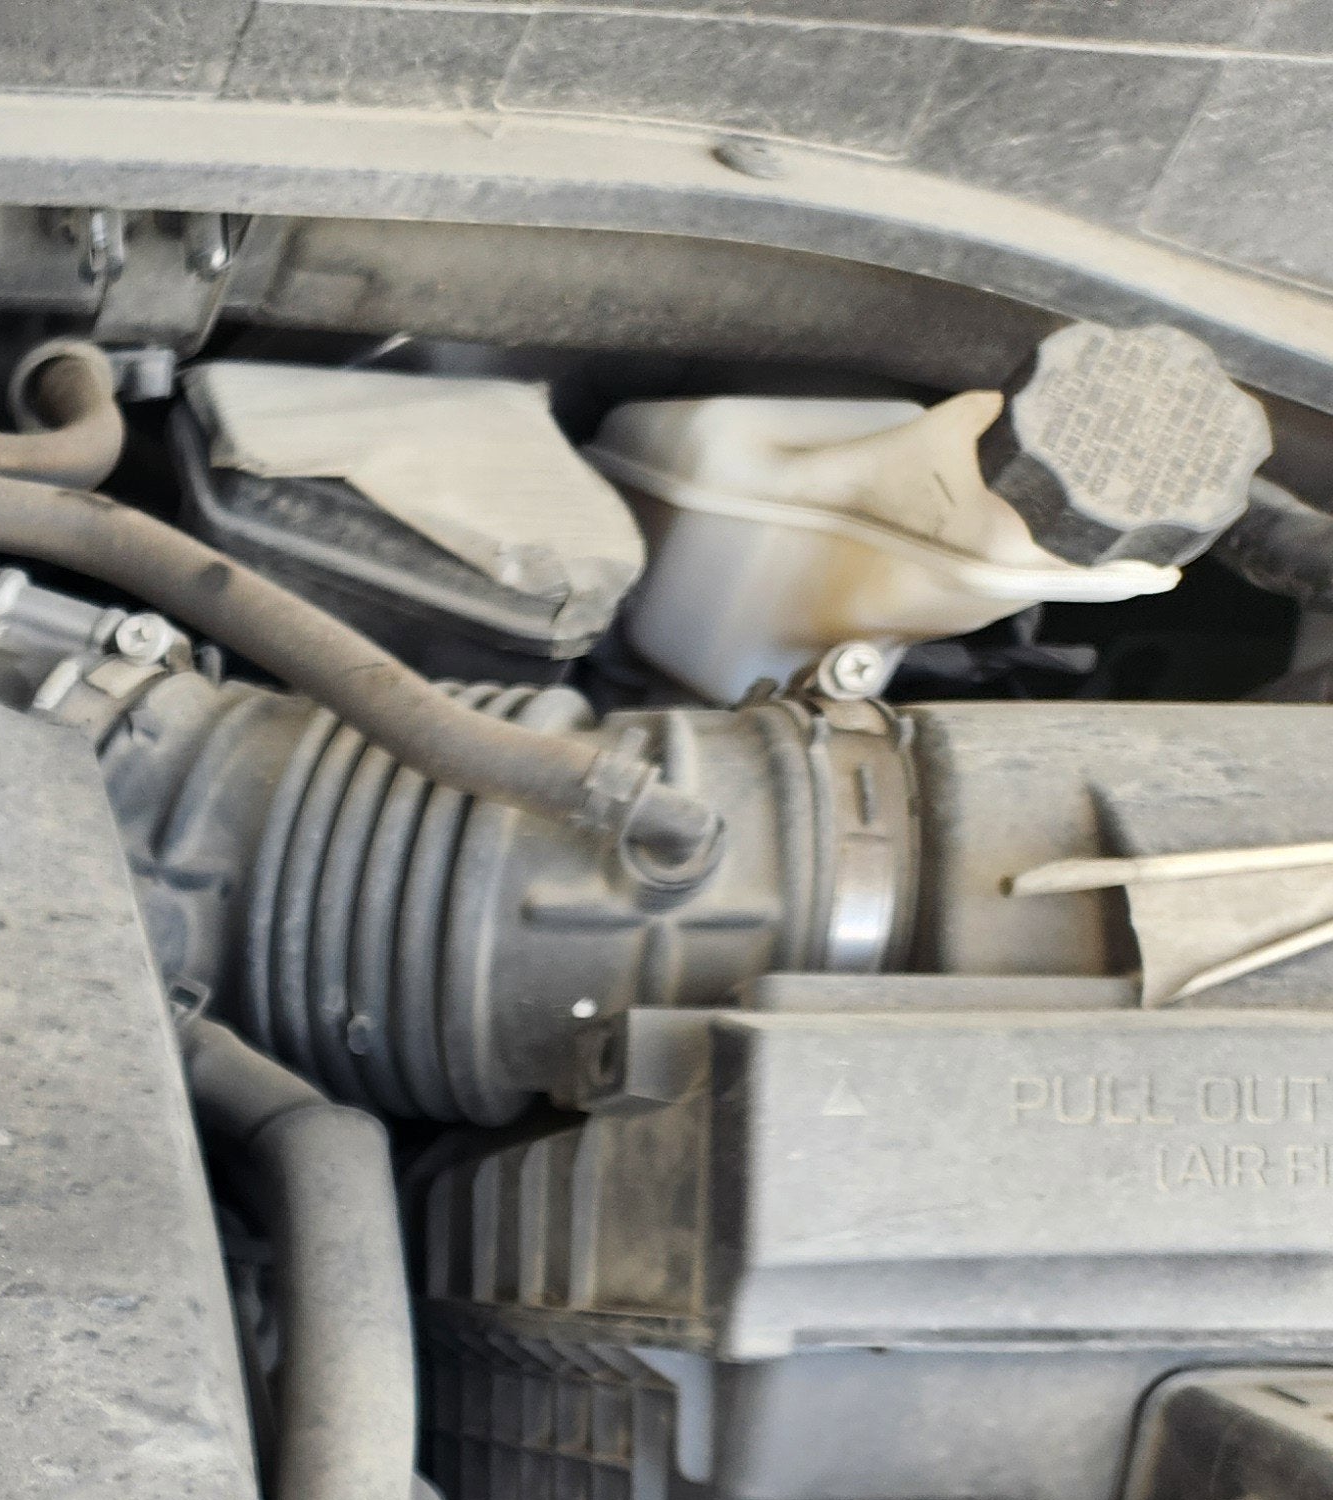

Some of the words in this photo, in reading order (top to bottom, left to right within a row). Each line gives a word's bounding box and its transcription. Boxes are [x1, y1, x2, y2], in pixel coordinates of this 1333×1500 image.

[1009, 1074, 1176, 1125] PULL
[1197, 1074, 1329, 1125] OUT
[1155, 1143, 1269, 1192] (AIR
